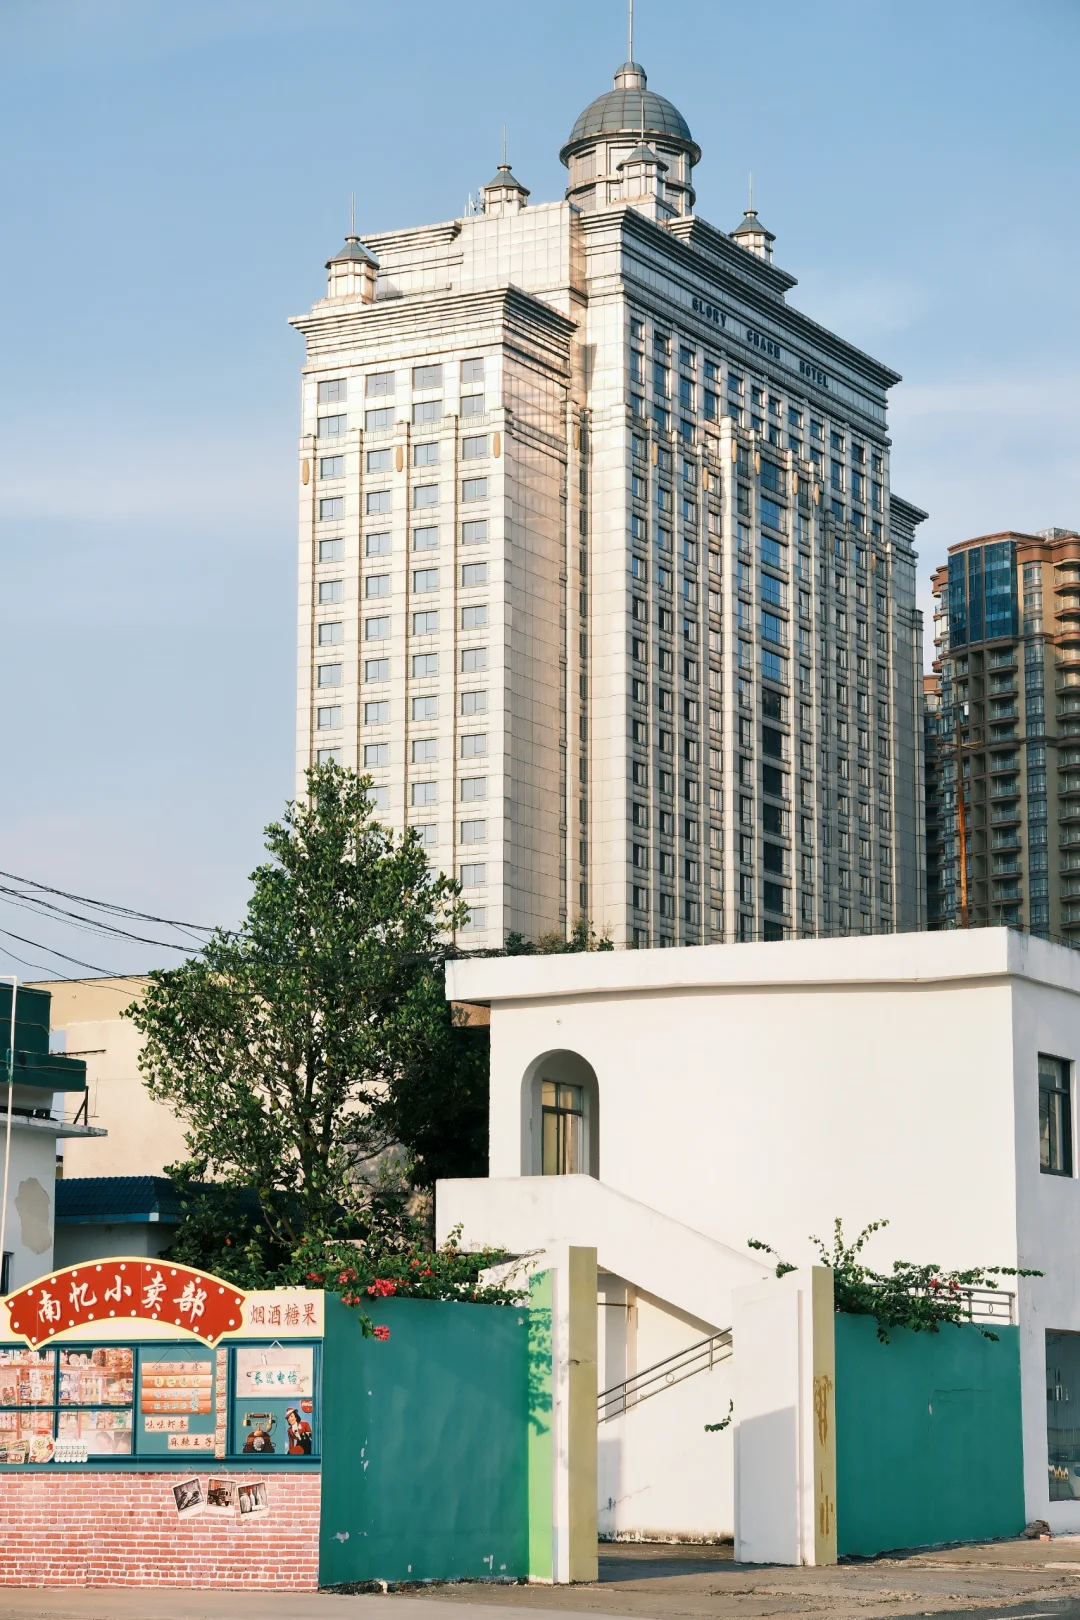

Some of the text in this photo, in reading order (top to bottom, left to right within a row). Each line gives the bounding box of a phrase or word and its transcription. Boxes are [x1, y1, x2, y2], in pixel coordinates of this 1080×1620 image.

[692, 297, 829, 389] GLORY CHARM HOTEL
[38, 1270, 208, 1324] 南忆小卖部
[249, 1302, 318, 1327] 烟酒糖果
